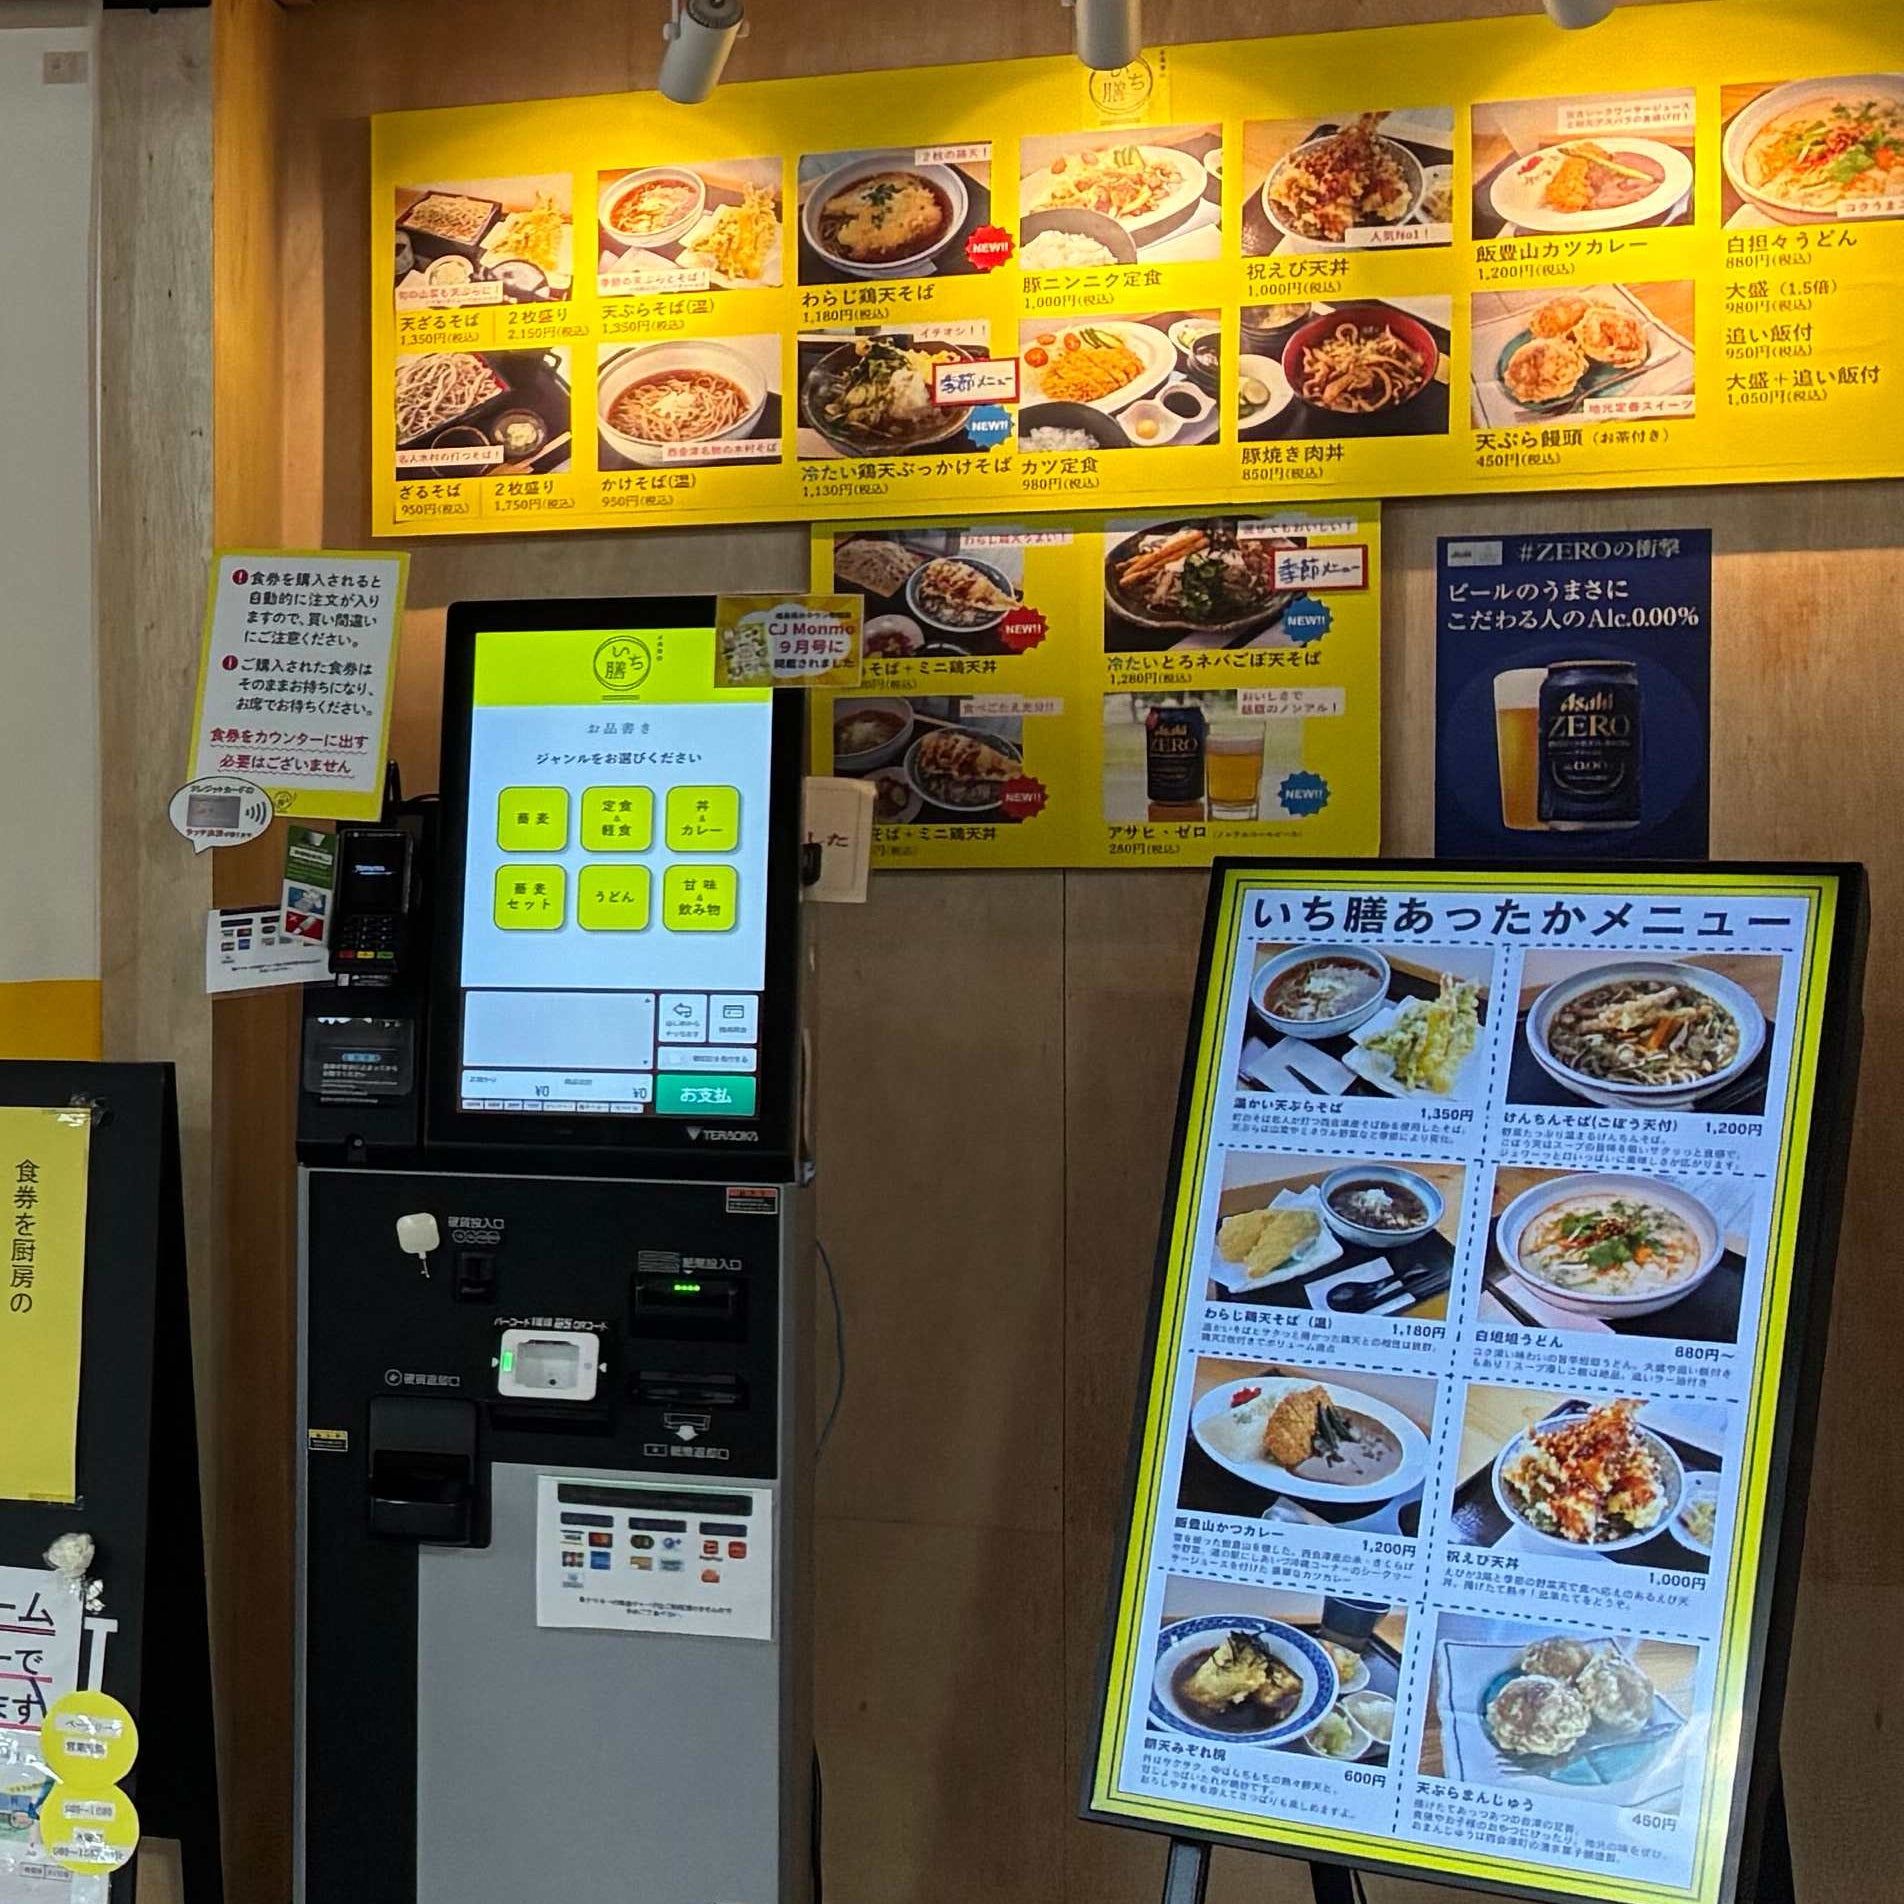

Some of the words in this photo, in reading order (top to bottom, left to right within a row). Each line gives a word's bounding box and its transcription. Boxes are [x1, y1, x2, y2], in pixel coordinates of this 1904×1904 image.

[1475, 239, 1649, 263] 飯豊山カツカレー
[1725, 251, 1813, 268] 880円(税込)
[1246, 258, 1350, 282] 祝えび天丼
[1477, 263, 1576, 281] 1,200円(税込)
[1022, 270, 1163, 294] 豚ニンニク定食
[1247, 281, 1342, 297] 1,000円(税込)
[800, 283, 935, 307] わらじ鶏天そば
[1023, 293, 1115, 310] 1,000円(税込)
[399, 311, 481, 332] 天ざるそば
[802, 307, 890, 324] 1,180円(税込)
[1725, 325, 1813, 345] 追い飯付
[1726, 366, 1881, 391] 大盛＋追い飯付
[1726, 389, 1828, 406] 1,050円(税込)
[1475, 429, 1583, 451] 天ぷら饅頭
[1241, 444, 1345, 464] 豚焼き肉丼
[800, 457, 1012, 481] 冷たい鶏天ぶっかけそば
[1021, 457, 1099, 475] カツ定食
[399, 481, 462, 499] ざるそば
[802, 483, 889, 498] 1,130円(税込)
[1021, 476, 1100, 491] 980円(税込)
[250, 571, 383, 589] 食券を購入されると
[248, 590, 381, 609] 自動的に注文が入り
[1448, 578, 1630, 603] ビールのうまさに
[246, 611, 378, 630] ますので、買い間違い
[768, 622, 789, 636] CJ
[1287, 614, 1326, 627] NEW!!
[244, 630, 359, 649] にご注意ください。
[778, 639, 844, 655] 9月号に
[240, 658, 373, 677] ご購入された食券は
[604, 643, 645, 680] いち膳
[1107, 651, 1321, 672] 冷たいとろネバごぼ天そば
[238, 677, 374, 697] そのままお持ちになり、
[234, 696, 373, 717] お席でお待ちください。
[1560, 690, 1615, 711] Asahi
[1547, 714, 1631, 738] ZERO
[209, 726, 369, 750] 食券をカウンターに出す
[218, 753, 352, 774] 必要はございません
[535, 751, 703, 766] ジャンルをお選びください
[601, 799, 632, 814] 定食
[680, 824, 723, 837] カレー
[1108, 825, 1207, 840] アサヒ・ゼロ
[506, 898, 552, 911] セット
[593, 890, 635, 904] うどん
[1253, 896, 1792, 938] いち膳あったかメニュー
[1233, 1097, 1344, 1114] 温かい天ぷらそば
[1420, 1107, 1475, 1122] 1,350円
[1705, 1121, 1763, 1137] 1,200円
[9, 1158, 40, 1314] 食券を厨房の
[1204, 1307, 1299, 1327] わらじ鶏天そば
[1392, 1323, 1446, 1339] 1,180円
[1674, 1346, 1736, 1362] 880円～
[1362, 1539, 1417, 1558] 1,200円
[1446, 1549, 1520, 1569] 祝えび天丼
[1649, 1572, 1707, 1591] 1,000円
[1344, 1769, 1387, 1788] 600円
[1415, 1780, 1534, 1812] 天ぷらまんじゅう
